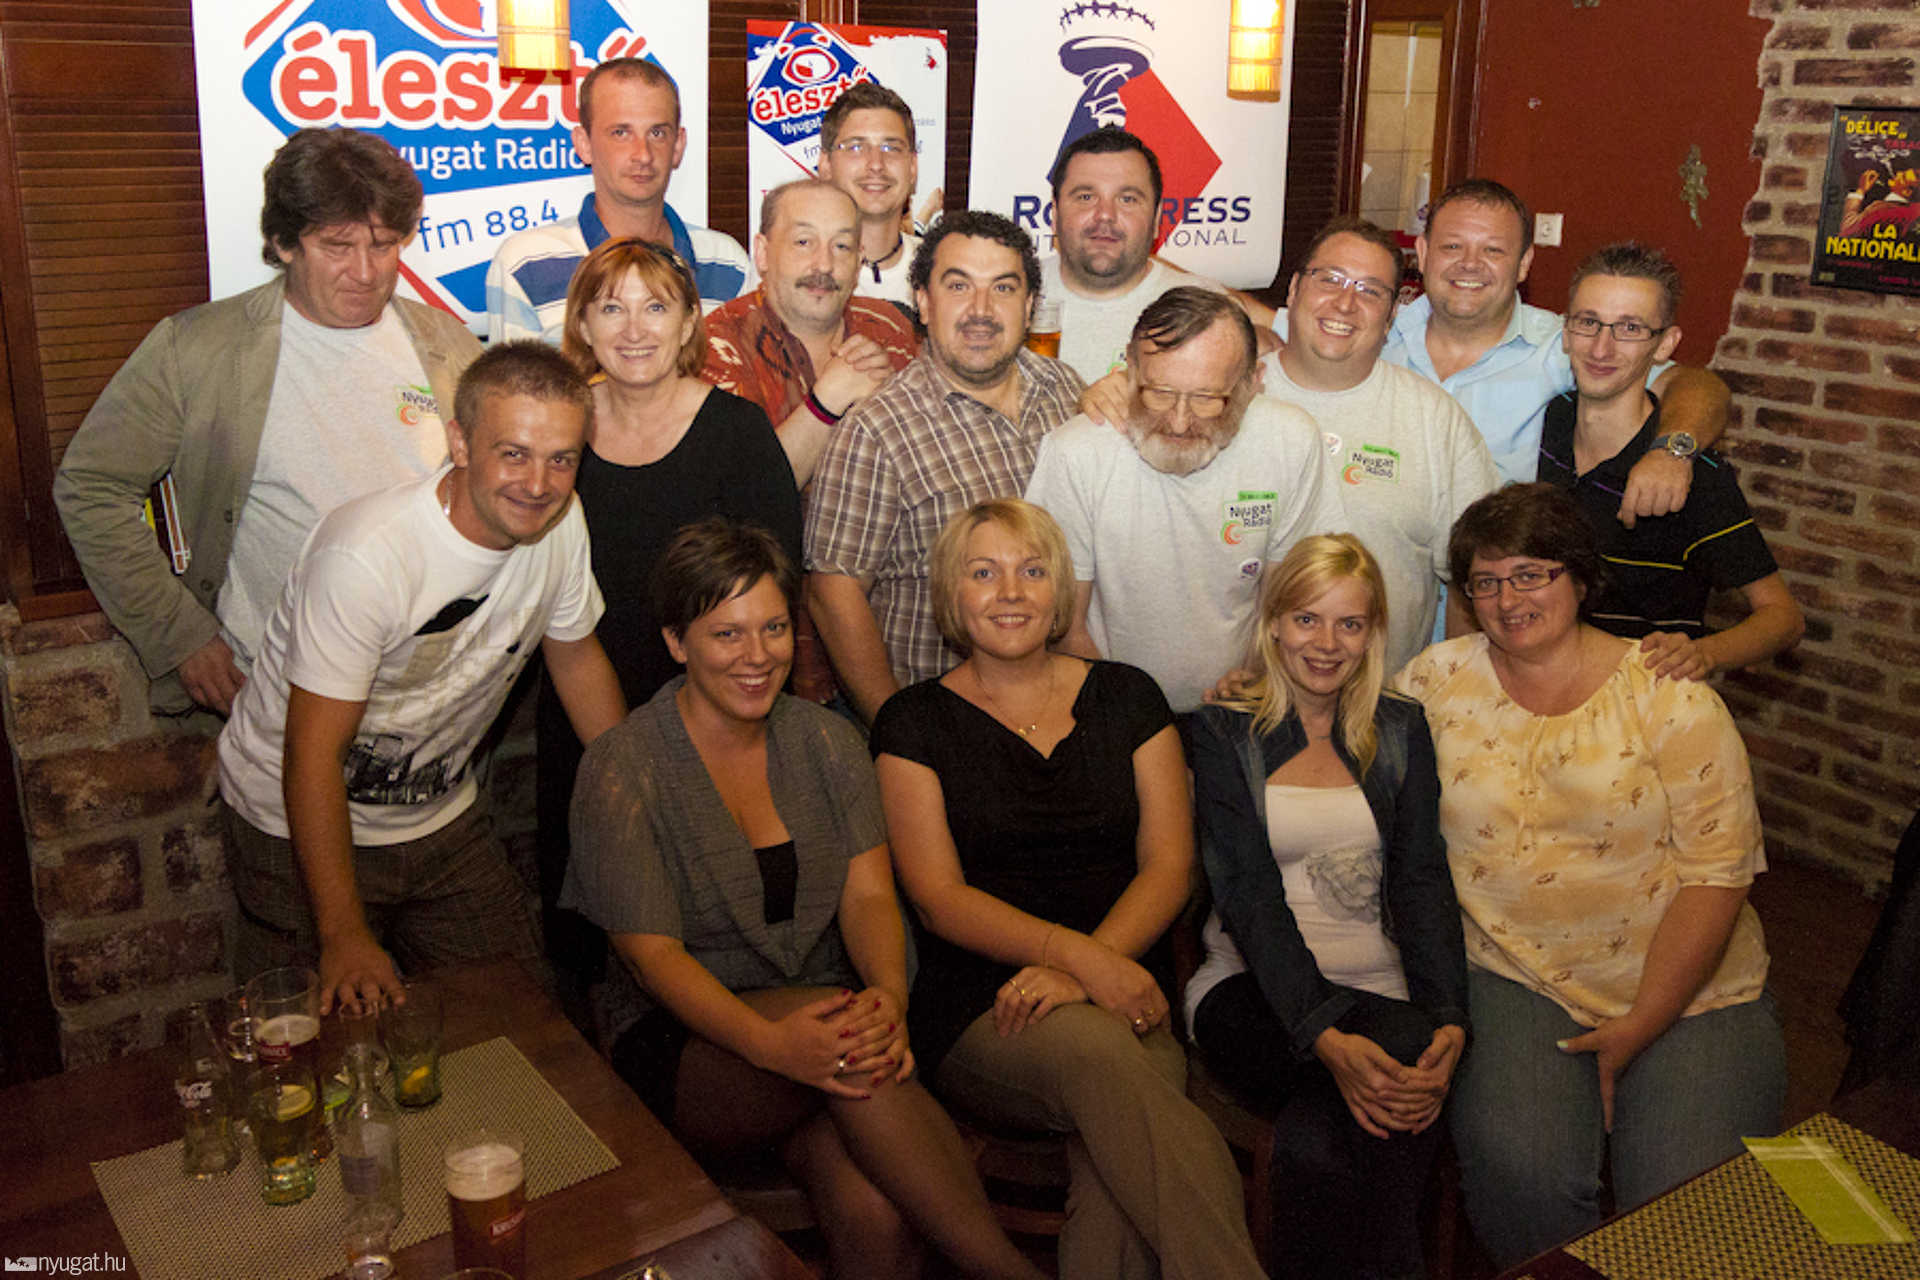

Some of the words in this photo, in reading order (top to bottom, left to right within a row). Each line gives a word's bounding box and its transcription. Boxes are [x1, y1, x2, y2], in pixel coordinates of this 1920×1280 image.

[280, 31, 646, 122] éleszt
[418, 216, 474, 253] fm
[485, 199, 559, 237] 88.4
[1873, 223, 1897, 239] LA
[1825, 235, 1920, 263] NATIONAL
